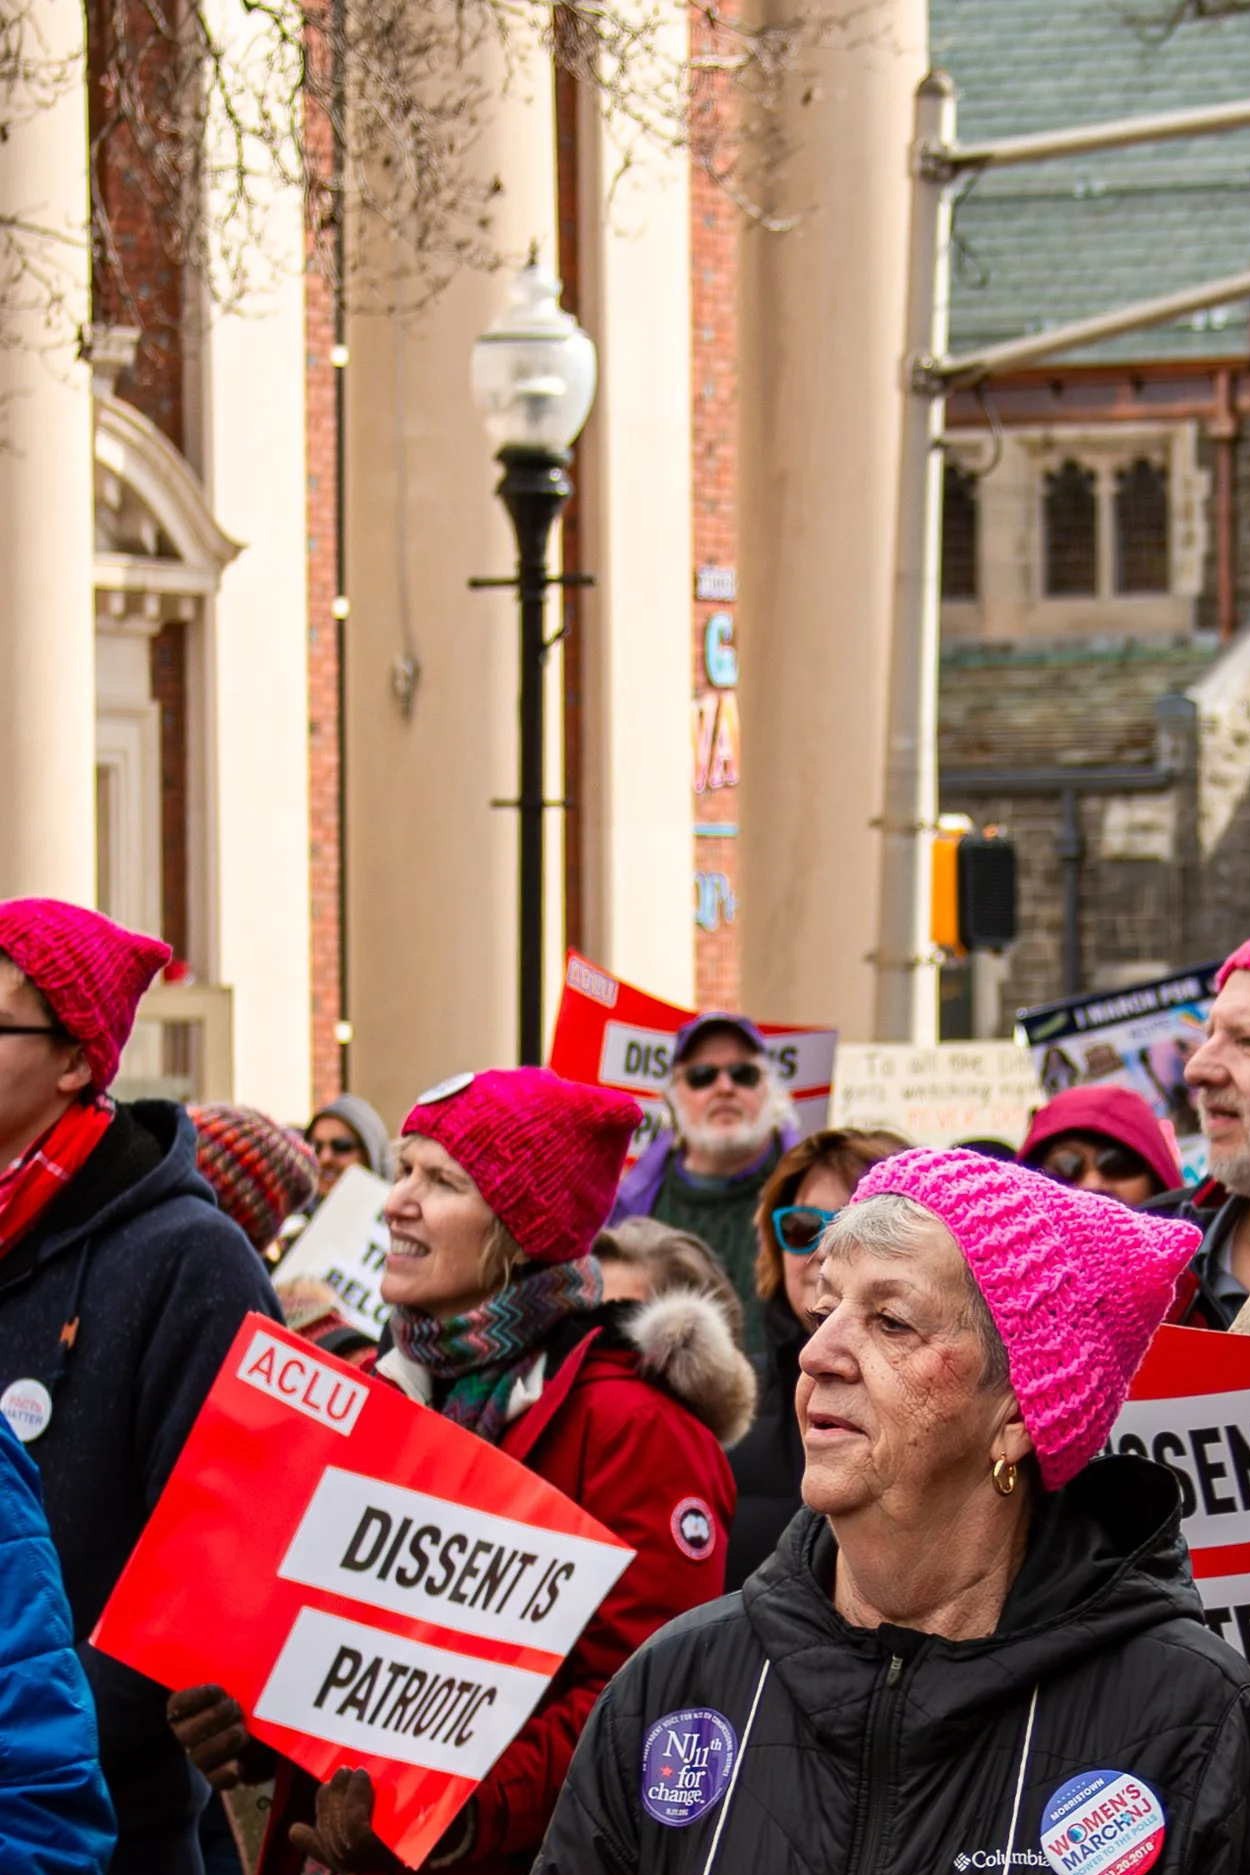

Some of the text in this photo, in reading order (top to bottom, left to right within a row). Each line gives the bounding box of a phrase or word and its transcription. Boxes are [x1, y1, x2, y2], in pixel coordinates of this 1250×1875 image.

[570, 964, 614, 999] ACLU
[1086, 989, 1158, 1022] MARCH
[1160, 977, 1201, 1006] FOR
[949, 1051, 984, 1076] the
[247, 1346, 357, 1422] ACLU
[339, 1505, 575, 1624] DISSENT IS
[312, 1645, 497, 1748] PATRIOTIC
[675, 1765, 706, 1789] for
[1050, 1777, 1105, 1821] MORRISTOWN
[1047, 1783, 1142, 1858] WOMEN'S
[1103, 1845, 1115, 1856] TO
[1115, 1833, 1131, 1848] THE
[1131, 1813, 1158, 1836] POLLS
